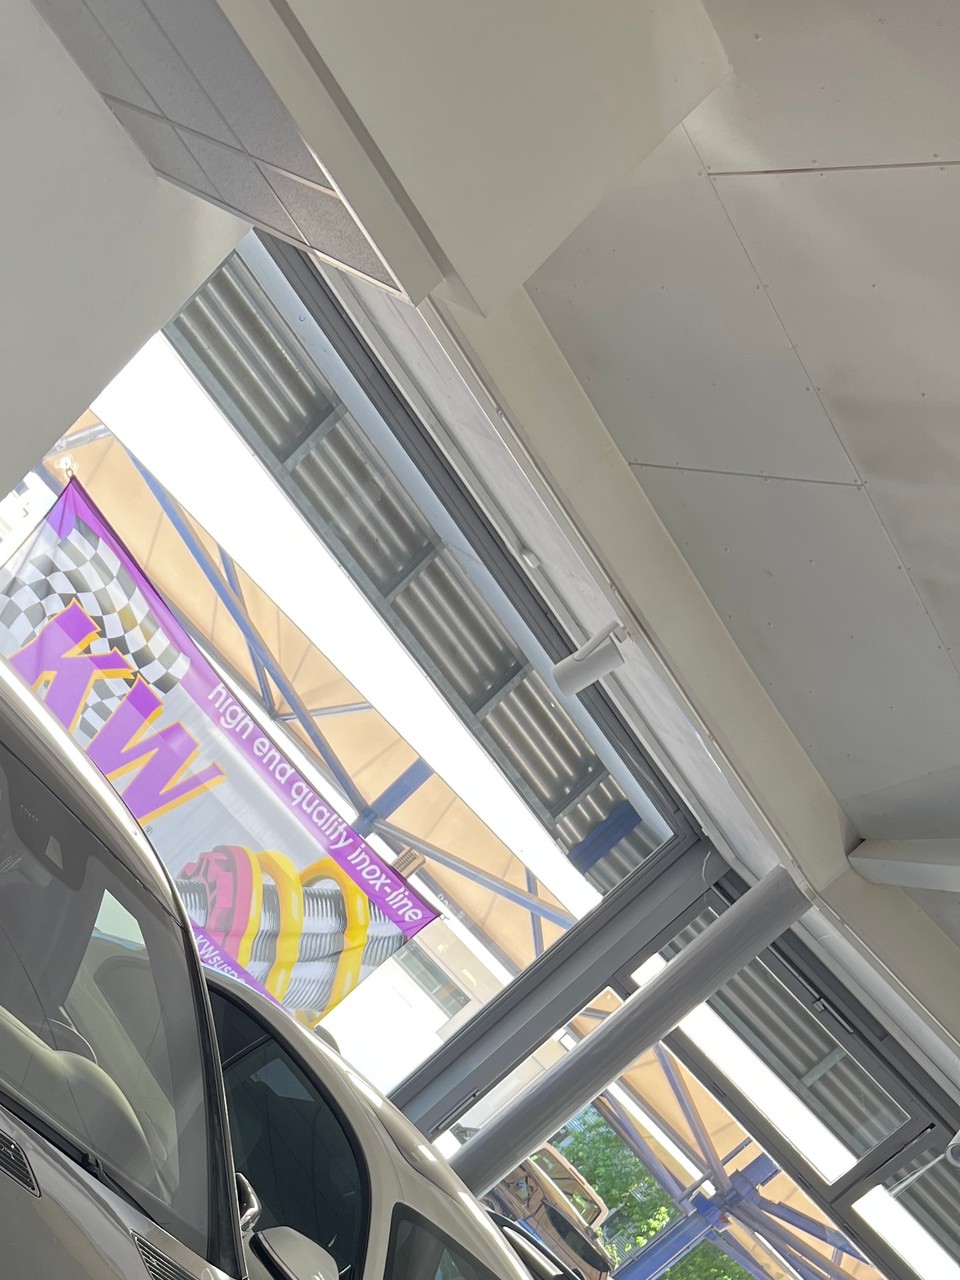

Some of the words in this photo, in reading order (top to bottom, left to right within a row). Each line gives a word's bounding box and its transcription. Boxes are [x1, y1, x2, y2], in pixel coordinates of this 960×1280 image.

[7, 597, 227, 826] KW
[207, 682, 254, 740] high
[253, 737, 296, 785] end
[290, 780, 354, 850] quality
[346, 843, 423, 922] inox-line
